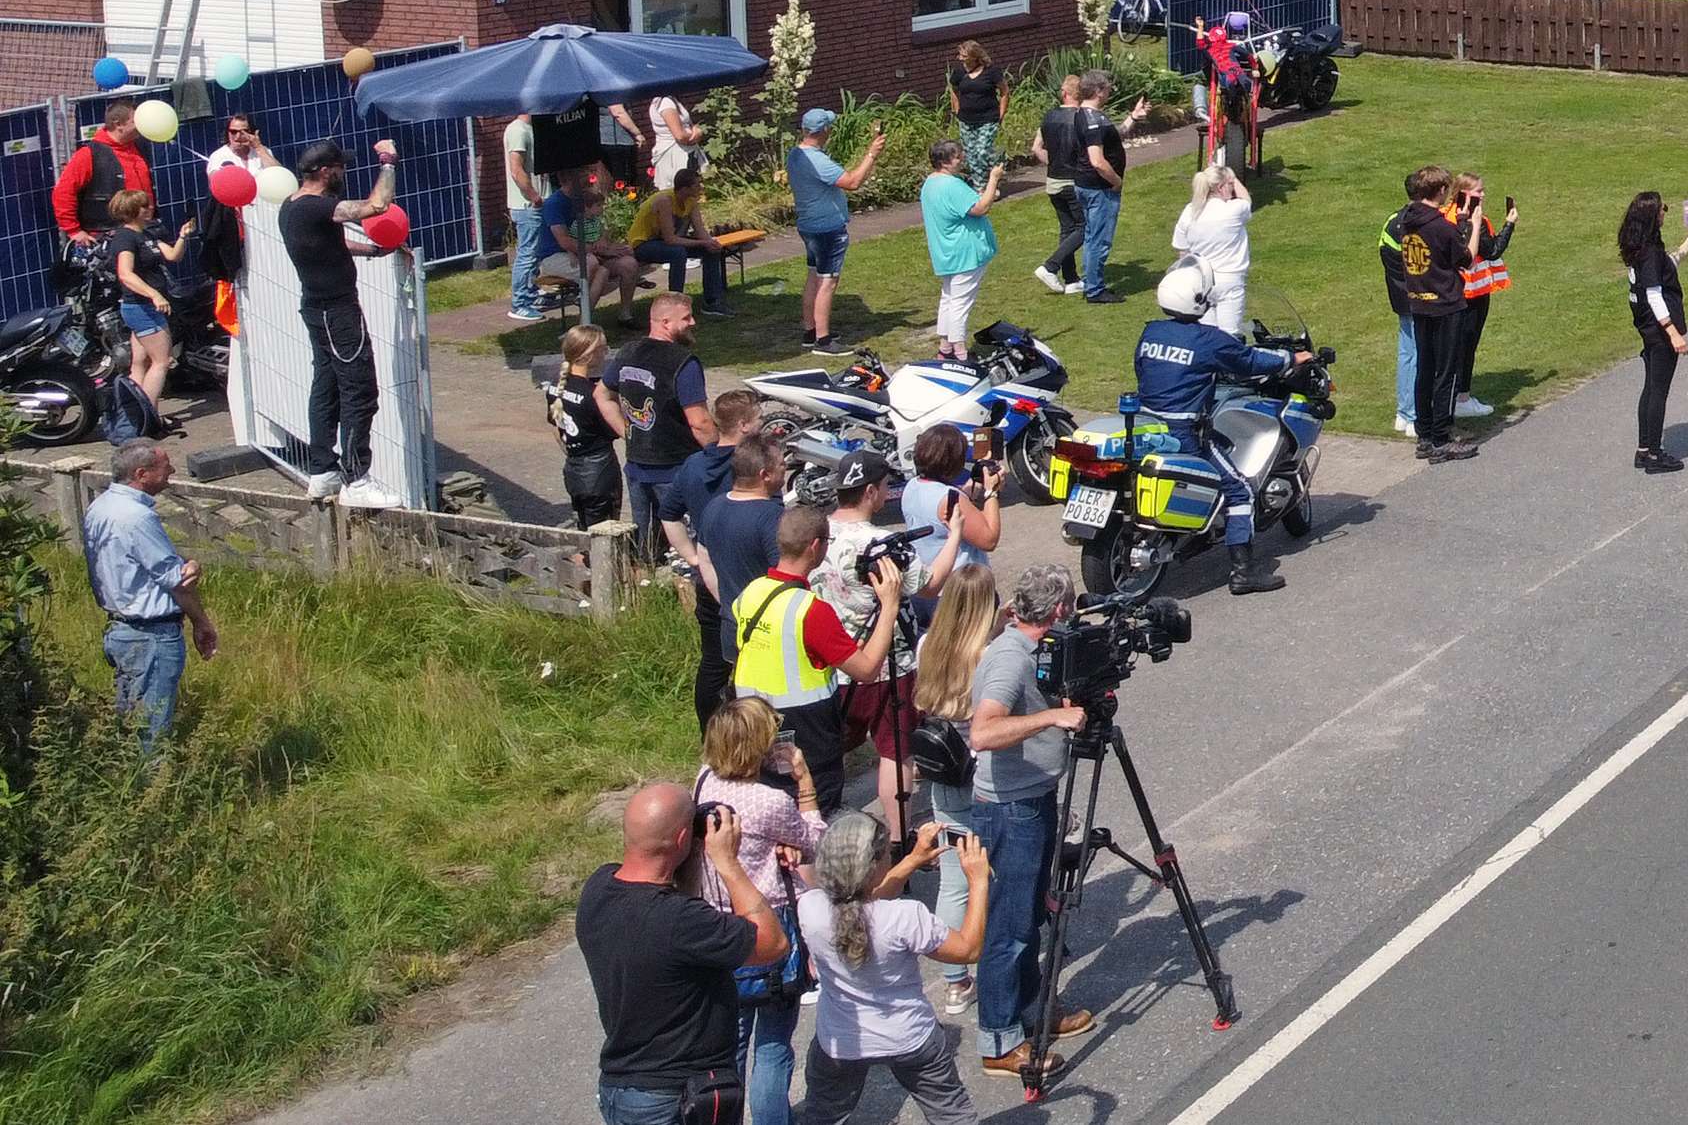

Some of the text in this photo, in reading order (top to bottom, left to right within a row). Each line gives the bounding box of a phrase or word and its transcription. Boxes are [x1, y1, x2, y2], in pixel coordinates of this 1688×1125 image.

[555, 107, 586, 124] KILIAN
[1139, 341, 1194, 366] POLIZEI
[1078, 487, 1103, 506] LER
[1064, 503, 1106, 524] PO 836
